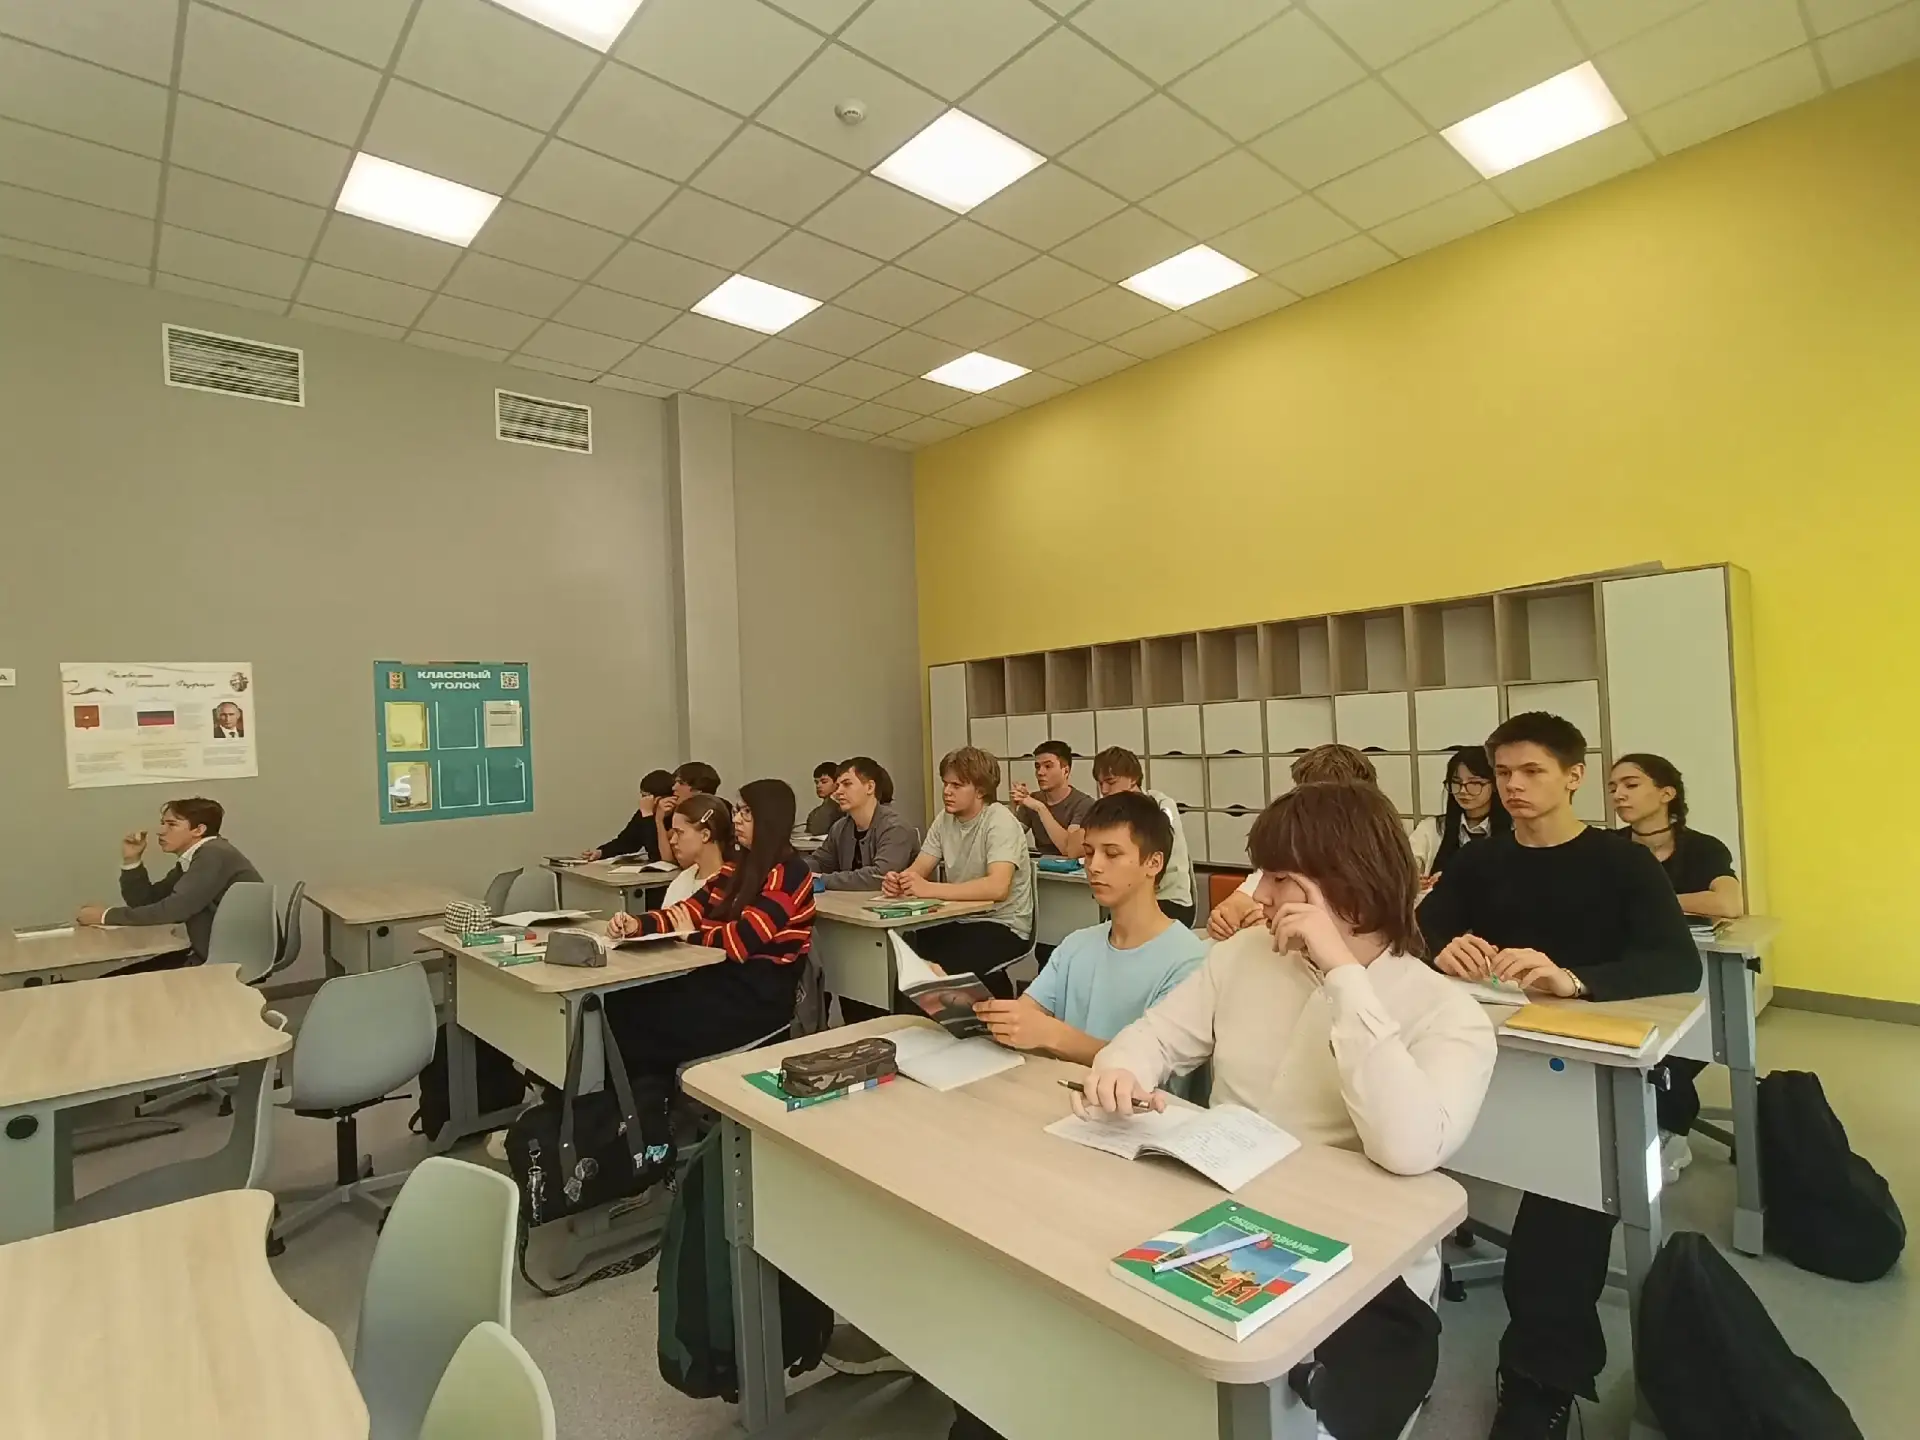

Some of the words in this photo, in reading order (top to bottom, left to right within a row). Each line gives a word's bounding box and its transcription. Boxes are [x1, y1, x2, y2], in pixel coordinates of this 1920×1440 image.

[417, 669, 491, 679] КЛАССНЫЙ
[429, 682, 480, 690] УГОЛОК
[1212, 1276, 1262, 1305] 11
